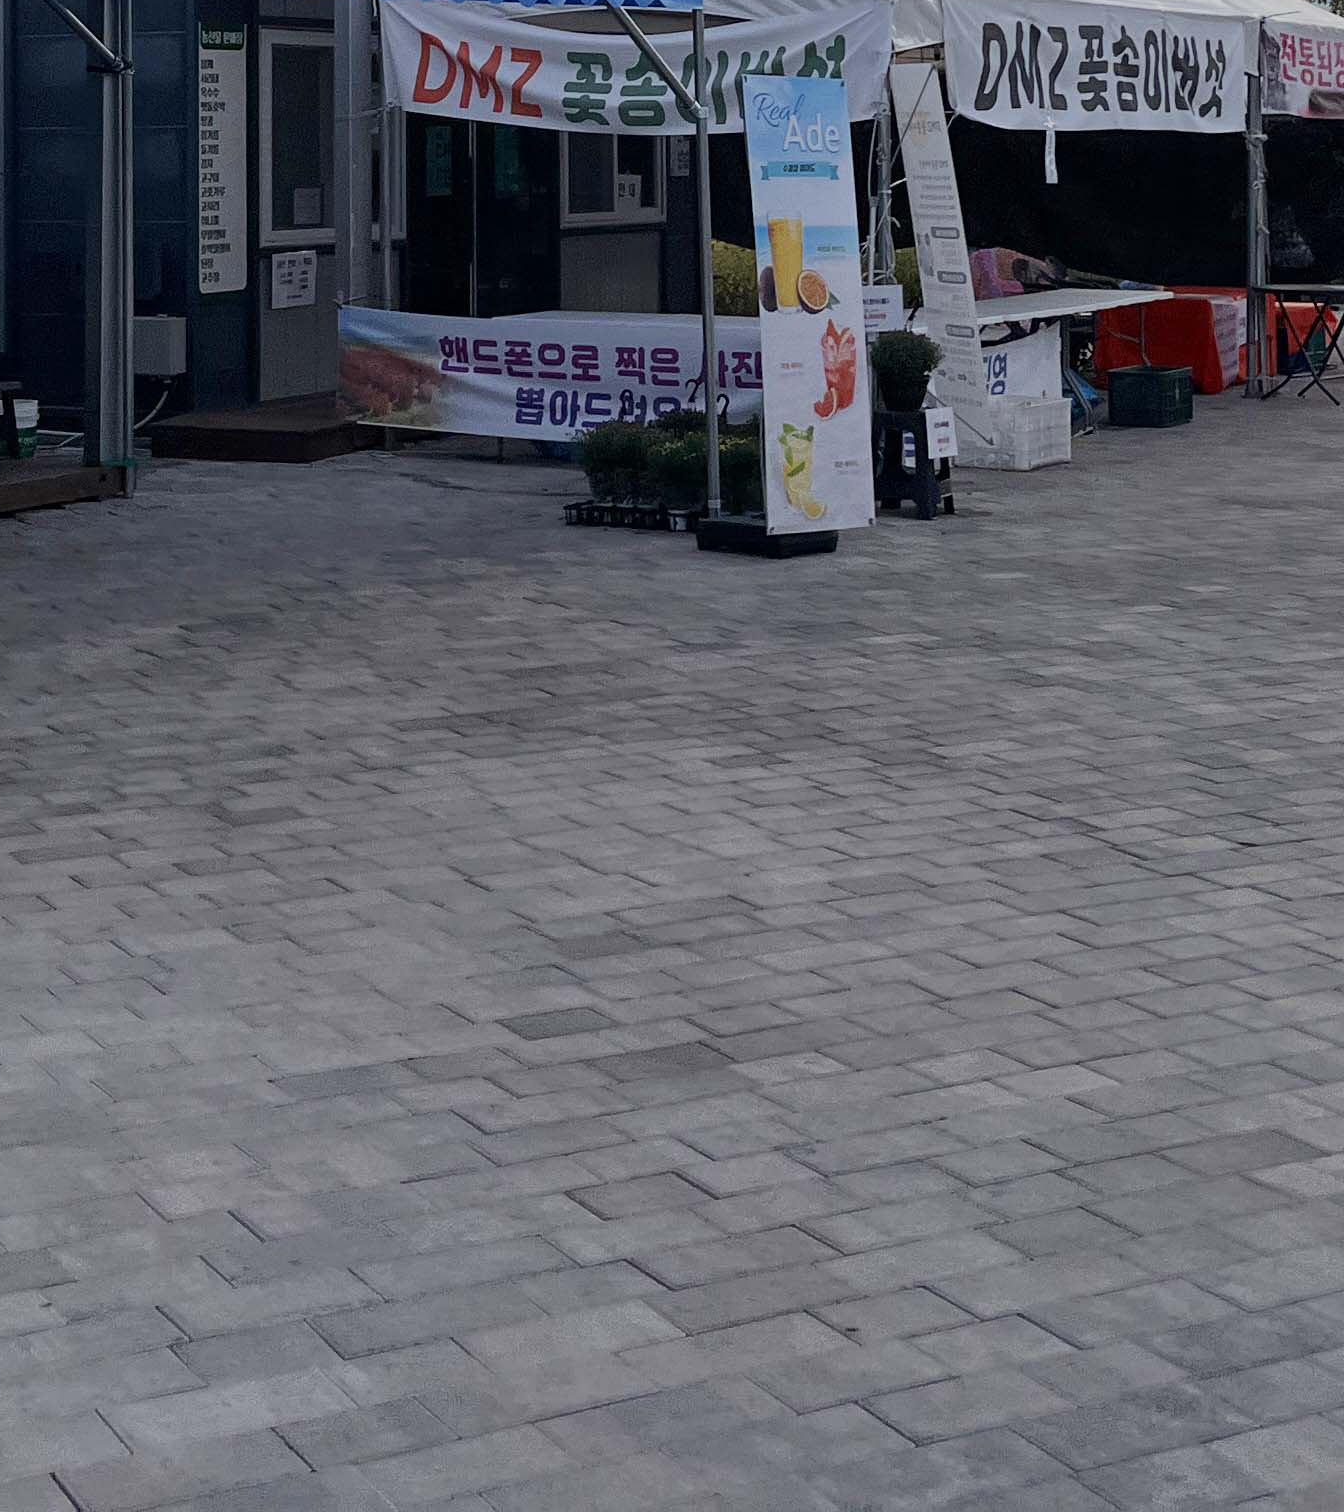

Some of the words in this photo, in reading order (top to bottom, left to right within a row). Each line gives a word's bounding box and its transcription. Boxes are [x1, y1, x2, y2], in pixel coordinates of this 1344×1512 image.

[413, 32, 542, 118] DMZ
[974, 21, 1069, 111] DMZ
[1077, 24, 1226, 118] 꽃송이버섯
[753, 92, 805, 128] Real
[782, 112, 840, 154] Ade
[439, 335, 601, 382] 핸드폰으로
[615, 346, 681, 387] 찍은
